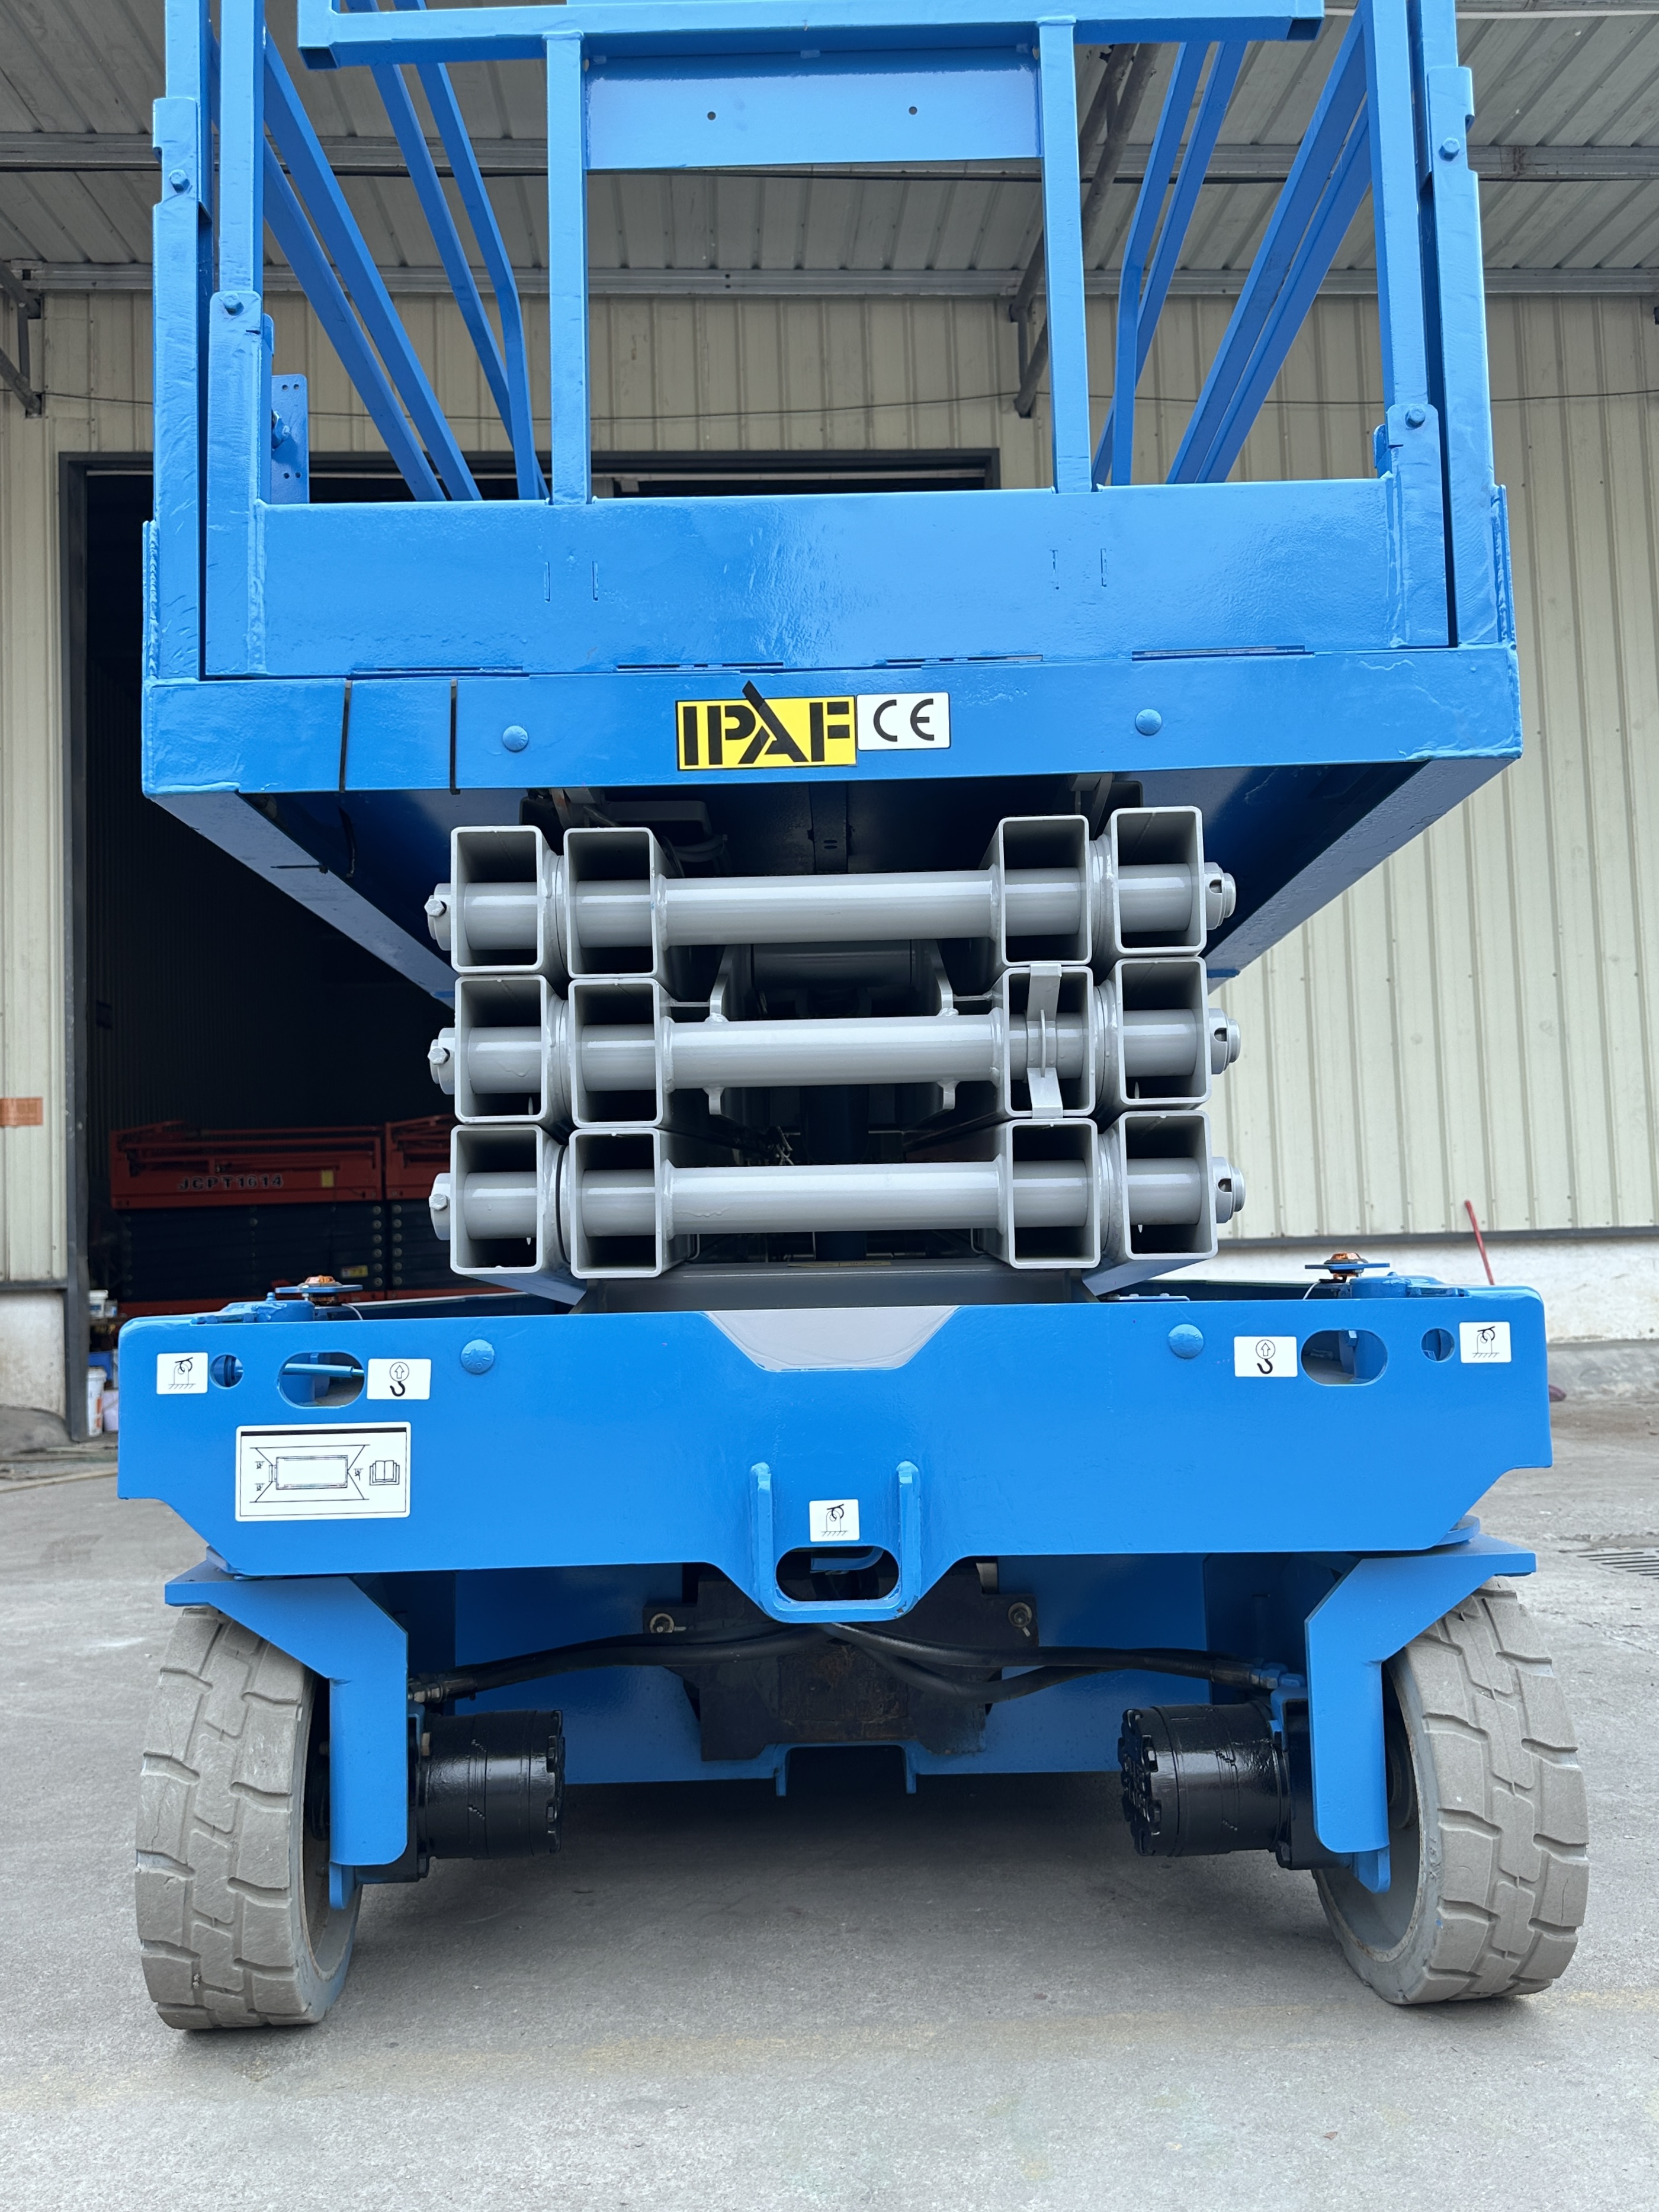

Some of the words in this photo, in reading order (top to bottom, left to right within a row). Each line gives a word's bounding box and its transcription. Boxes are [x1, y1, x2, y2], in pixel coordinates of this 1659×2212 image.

[682, 680, 851, 766] IPAF
[873, 698, 935, 742] CE
[179, 1174, 283, 1192] JCPT1614
